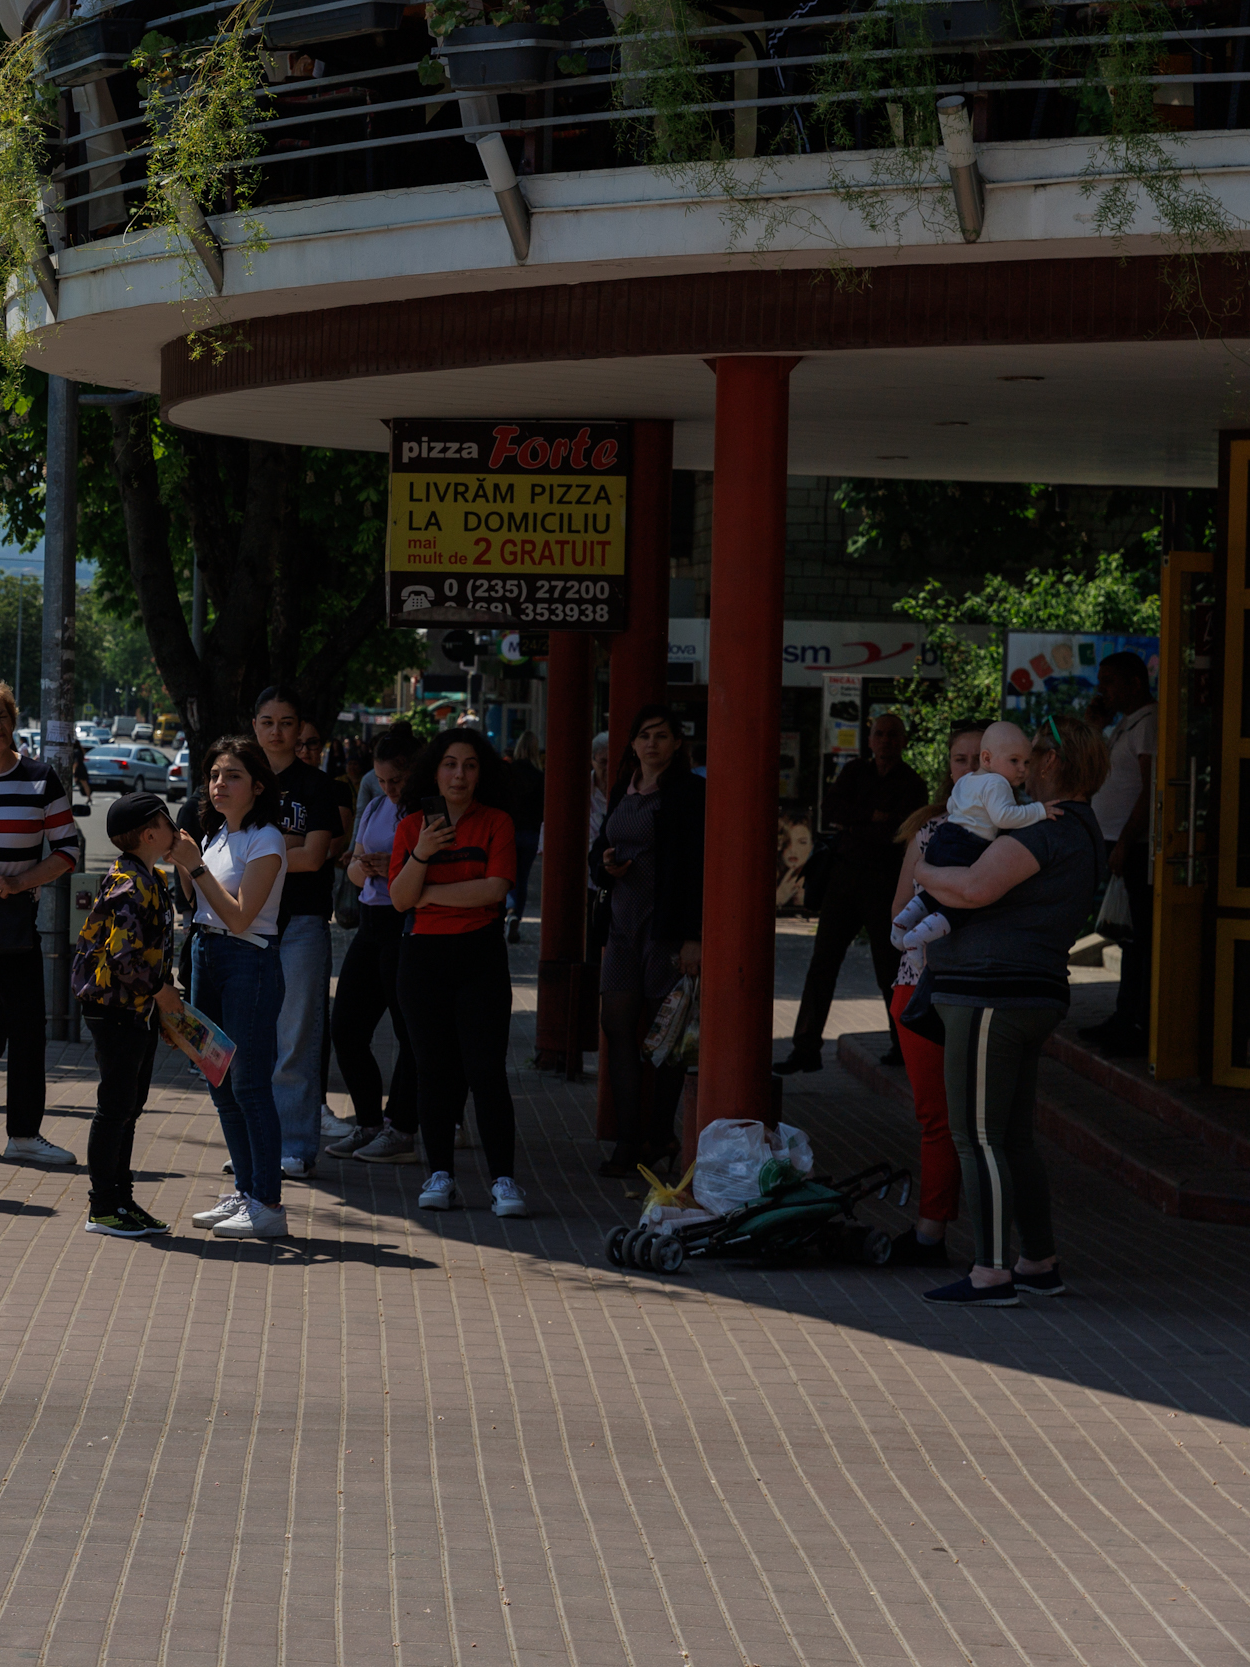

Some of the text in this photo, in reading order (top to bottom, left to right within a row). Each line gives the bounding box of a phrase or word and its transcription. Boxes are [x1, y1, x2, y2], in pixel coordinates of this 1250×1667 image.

[402, 425, 619, 470] pizza Forte
[409, 477, 612, 505] LIVRĂM PIZZA
[408, 510, 611, 534] LA DOMICILIU
[408, 536, 437, 549] mai
[408, 537, 611, 566] mult de 2 GRATUIT
[443, 578, 610, 602] 0 (235) 27200
[520, 602, 610, 622] 353938
[783, 644, 831, 664] sm
